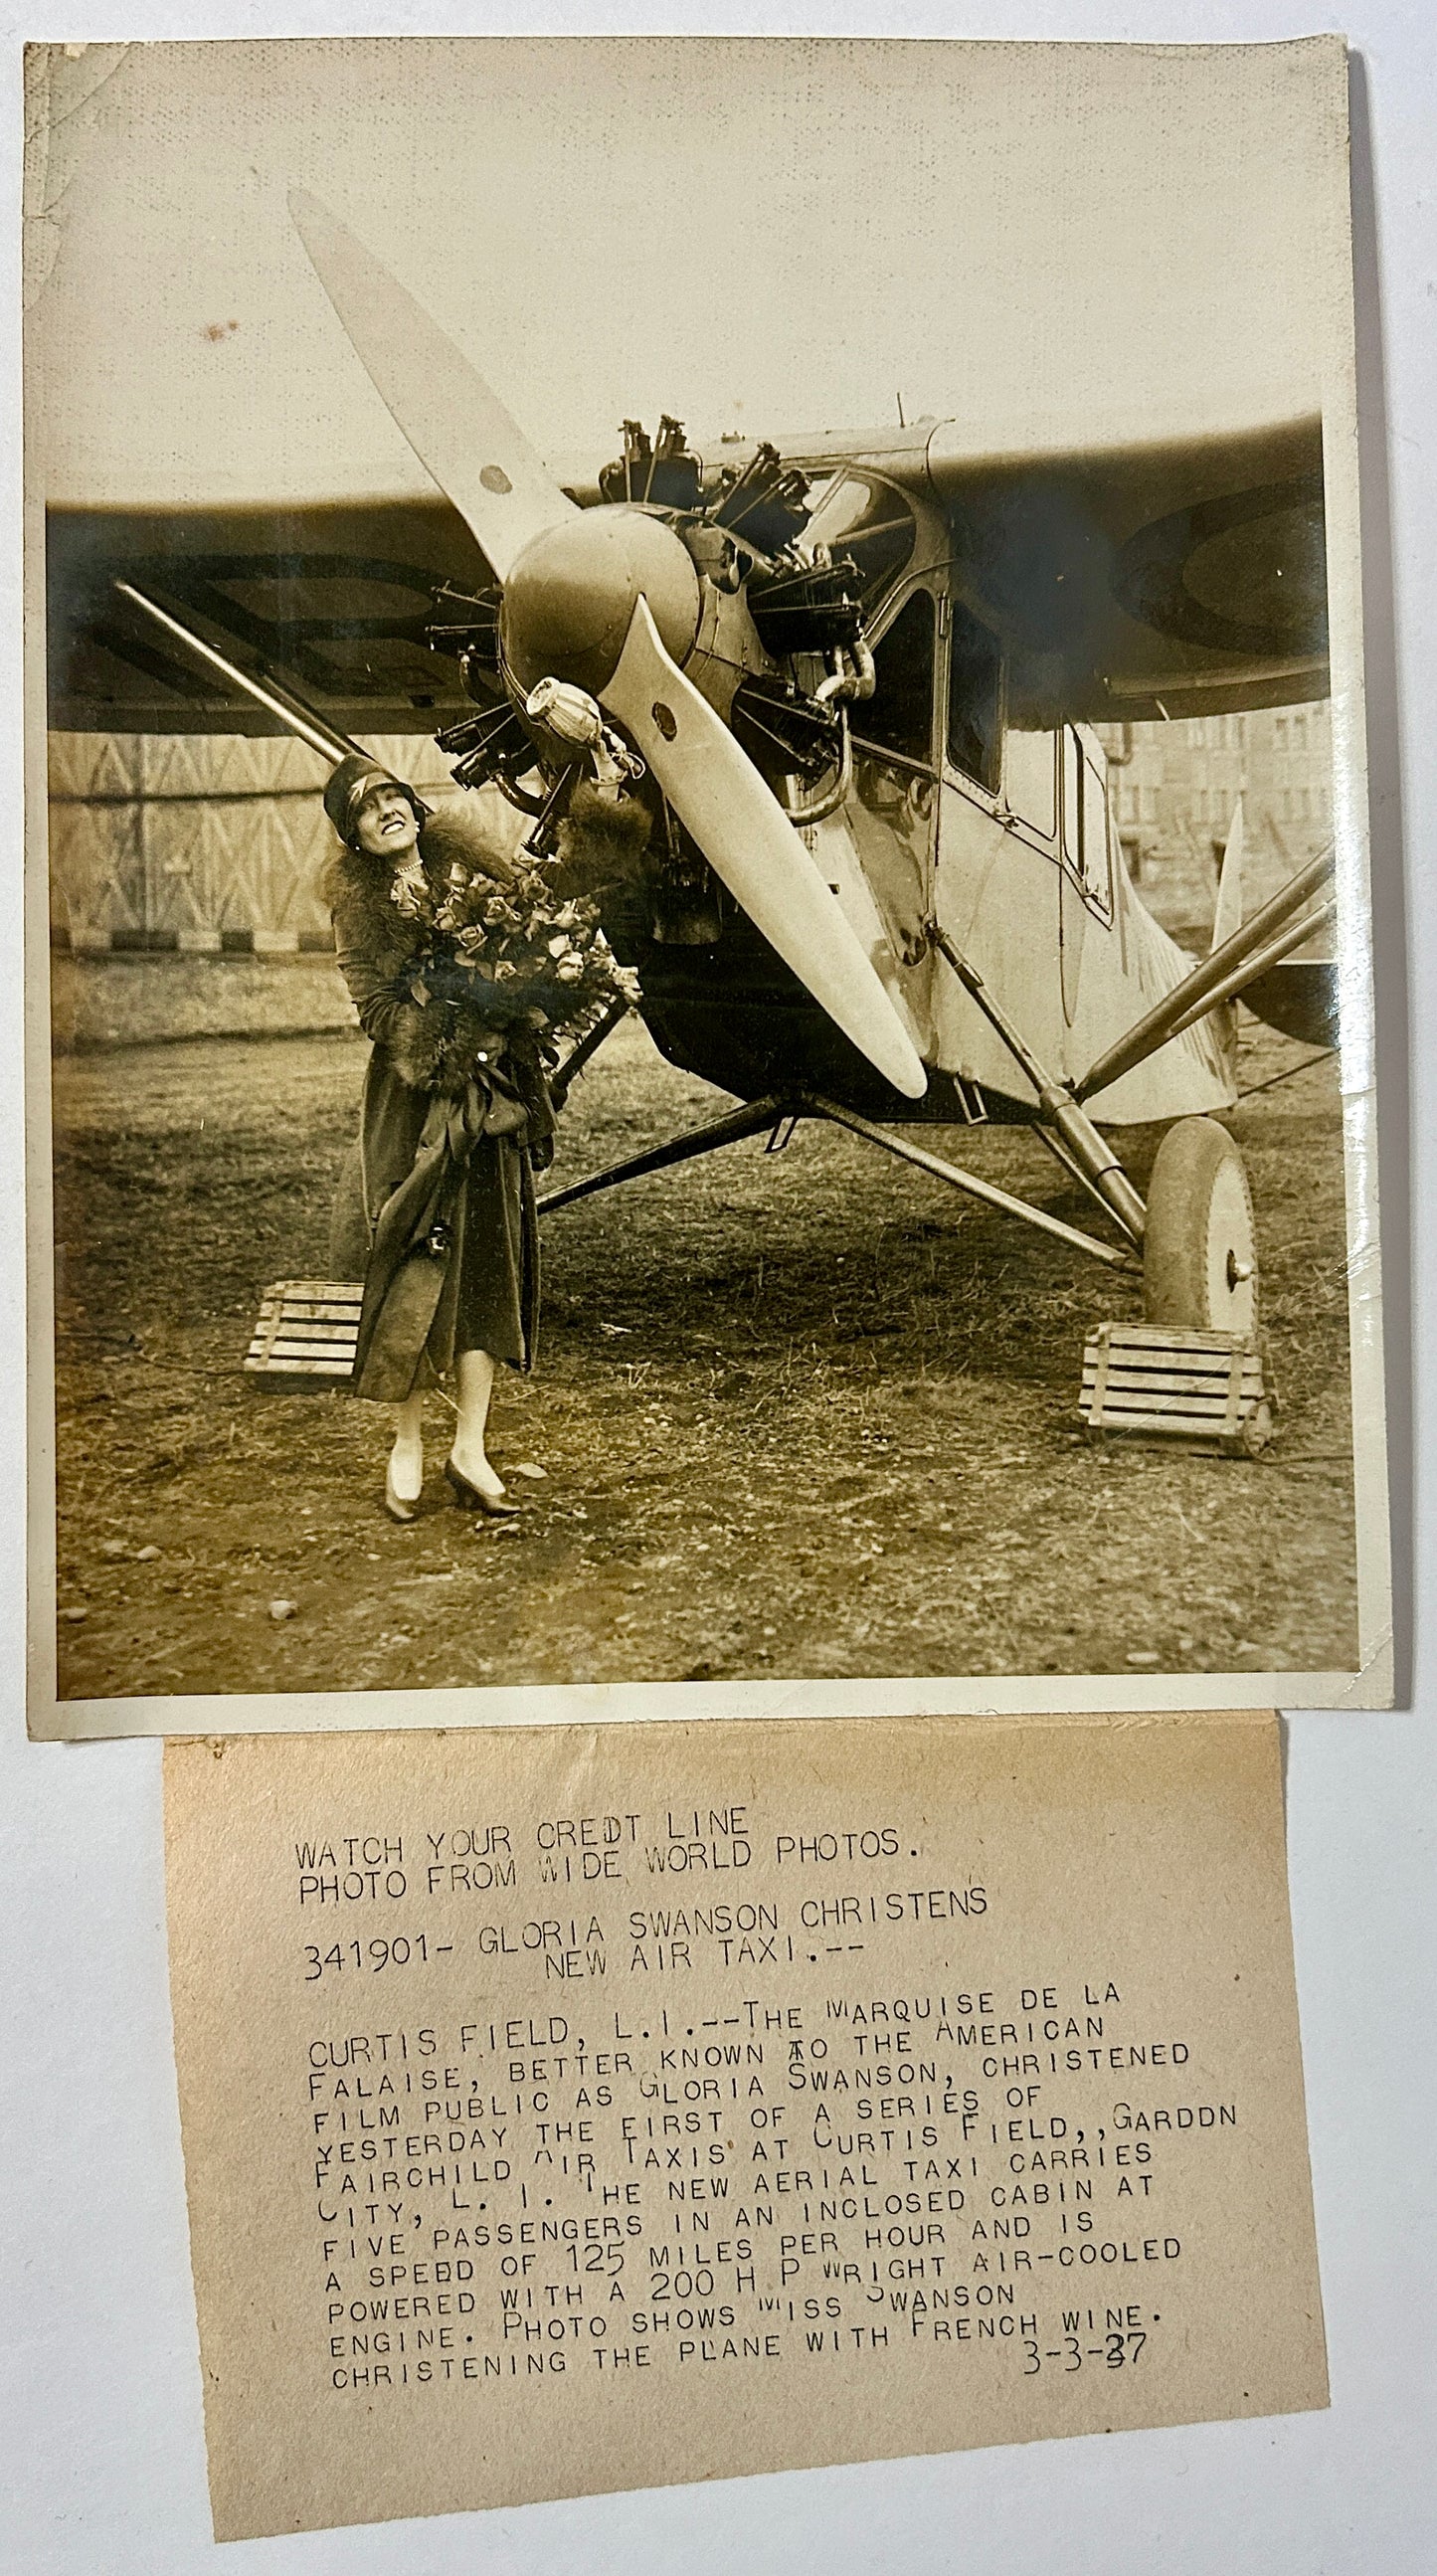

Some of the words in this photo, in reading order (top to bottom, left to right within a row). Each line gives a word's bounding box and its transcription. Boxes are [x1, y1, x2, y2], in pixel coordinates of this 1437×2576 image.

[295, 1836, 403, 1869] WATCH
[427, 1825, 511, 1859] YOUR
[668, 1807, 750, 1839] LINE
[300, 1870, 407, 1904] PHOTO
[428, 1858, 516, 1894] FROM
[540, 1851, 622, 1883] WIDE
[645, 1840, 751, 1873] WORLD
[777, 1829, 918, 1863] PHOTOS.
[479, 1916, 604, 1954] GLORIA
[629, 1904, 779, 1940] SWANSON
[802, 1887, 987, 1929] CHRISTENS
[546, 1950, 606, 1979] NEW
[631, 1941, 691, 1972] AIR
[309, 2029, 437, 2068] CURTIS
[461, 2017, 585, 2051] FIELD,
[826, 1993, 994, 2022] MARQUISE
[1021, 1988, 1058, 2010] DE
[1085, 1982, 1120, 2005] LA
[309, 2068, 478, 2101] FALAISE,
[509, 2053, 632, 2083] BETTER
[661, 2044, 764, 2070] KNOWN
[854, 2031, 912, 2055] THE
[936, 2017, 1104, 2047] AMERICAN
[314, 2106, 400, 2134] FILM
[425, 2092, 550, 2122] PUBLIC
[577, 2086, 613, 2108] AS
[639, 2072, 764, 2104] GLORIA
[789, 2062, 953, 2088] SWANSON,
[983, 2043, 1189, 2078] CHRISTENED
[317, 2127, 507, 2166] YESTERDAY
[537, 2121, 594, 2144] THE
[622, 2112, 722, 2137] FIRST
[751, 2107, 786, 2128] OF
[815, 2104, 830, 2123] A
[857, 2091, 979, 2119] SERIES
[1006, 2086, 1041, 2108] OF
[314, 2160, 511, 2194] FAIRCHILD
[752, 2139, 789, 2161] AT
[813, 2125, 938, 2155] CURTIS
[669, 2178, 728, 2201] NEW
[755, 2165, 877, 2194] AERIAL
[903, 2157, 978, 2181] TAXI
[1009, 2142, 1153, 2173] CARRIES
[323, 2234, 406, 2261] FIVE
[434, 2215, 642, 2250] PASSENGERS
[675, 2212, 710, 2233] IN
[735, 2206, 774, 2228] AN
[804, 2190, 965, 2222] INCLOSED
[990, 2179, 1093, 2207] CABIN
[1118, 2175, 1154, 2197] AT
[326, 2272, 341, 2293] A
[501, 2254, 536, 2276] OF
[567, 2240, 625, 2276] 125
[649, 2239, 753, 2268] MILES
[781, 2233, 838, 2256] PER
[865, 2224, 945, 2249] HOUR
[972, 2216, 1030, 2240] AND
[1062, 2211, 1093, 2233] IS
[328, 2293, 475, 2323] POWERED
[501, 2285, 584, 2309] WITH
[610, 2281, 625, 2301] A
[651, 2269, 714, 2300] 200
[822, 2257, 947, 2284] WRIGHT
[973, 2238, 1181, 2273] AIR-COOLED
[331, 2327, 473, 2357] ENGINE.
[503, 2311, 607, 2340] PHOTO
[632, 2306, 735, 2332] SHOWS
[332, 2351, 566, 2389] CHRISTENING
[594, 2346, 651, 2368] THE
[680, 2335, 781, 2362] PLANE
[807, 2326, 889, 2353] WITH
[912, 2310, 1037, 2340] FRENCH
[1062, 2305, 1161, 2331] WINE.
